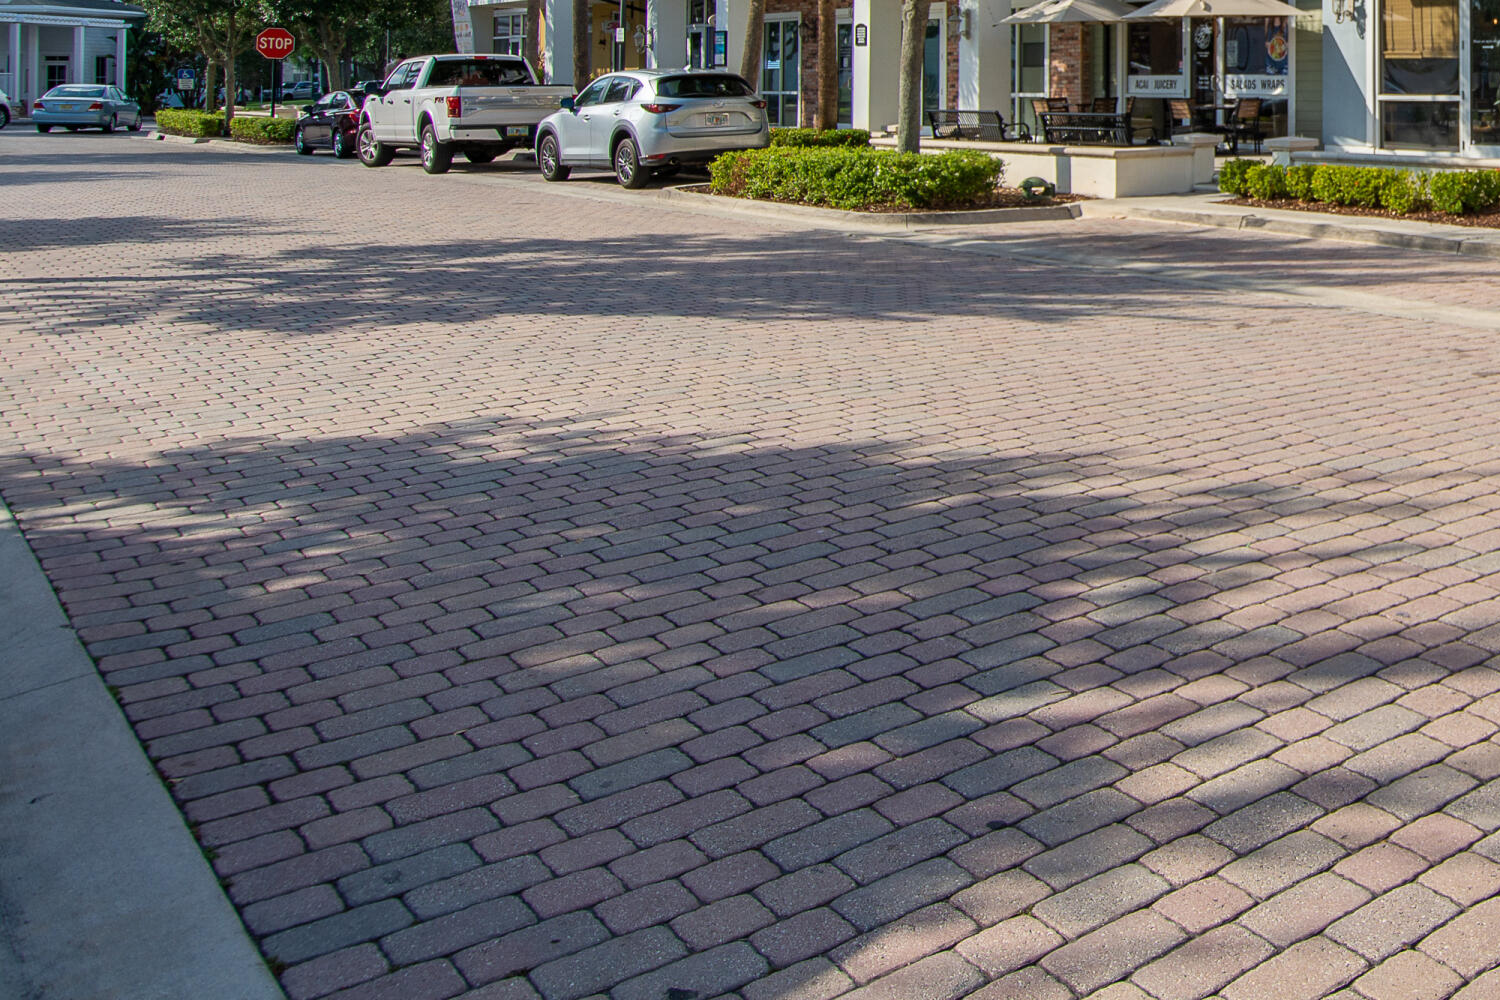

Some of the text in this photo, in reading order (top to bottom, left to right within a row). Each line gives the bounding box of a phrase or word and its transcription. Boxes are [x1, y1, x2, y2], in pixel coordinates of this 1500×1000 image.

[259, 37, 292, 49] STOP
[1154, 79, 1177, 89] JUICERY
[1231, 79, 1285, 90] SALADS WRAPS
